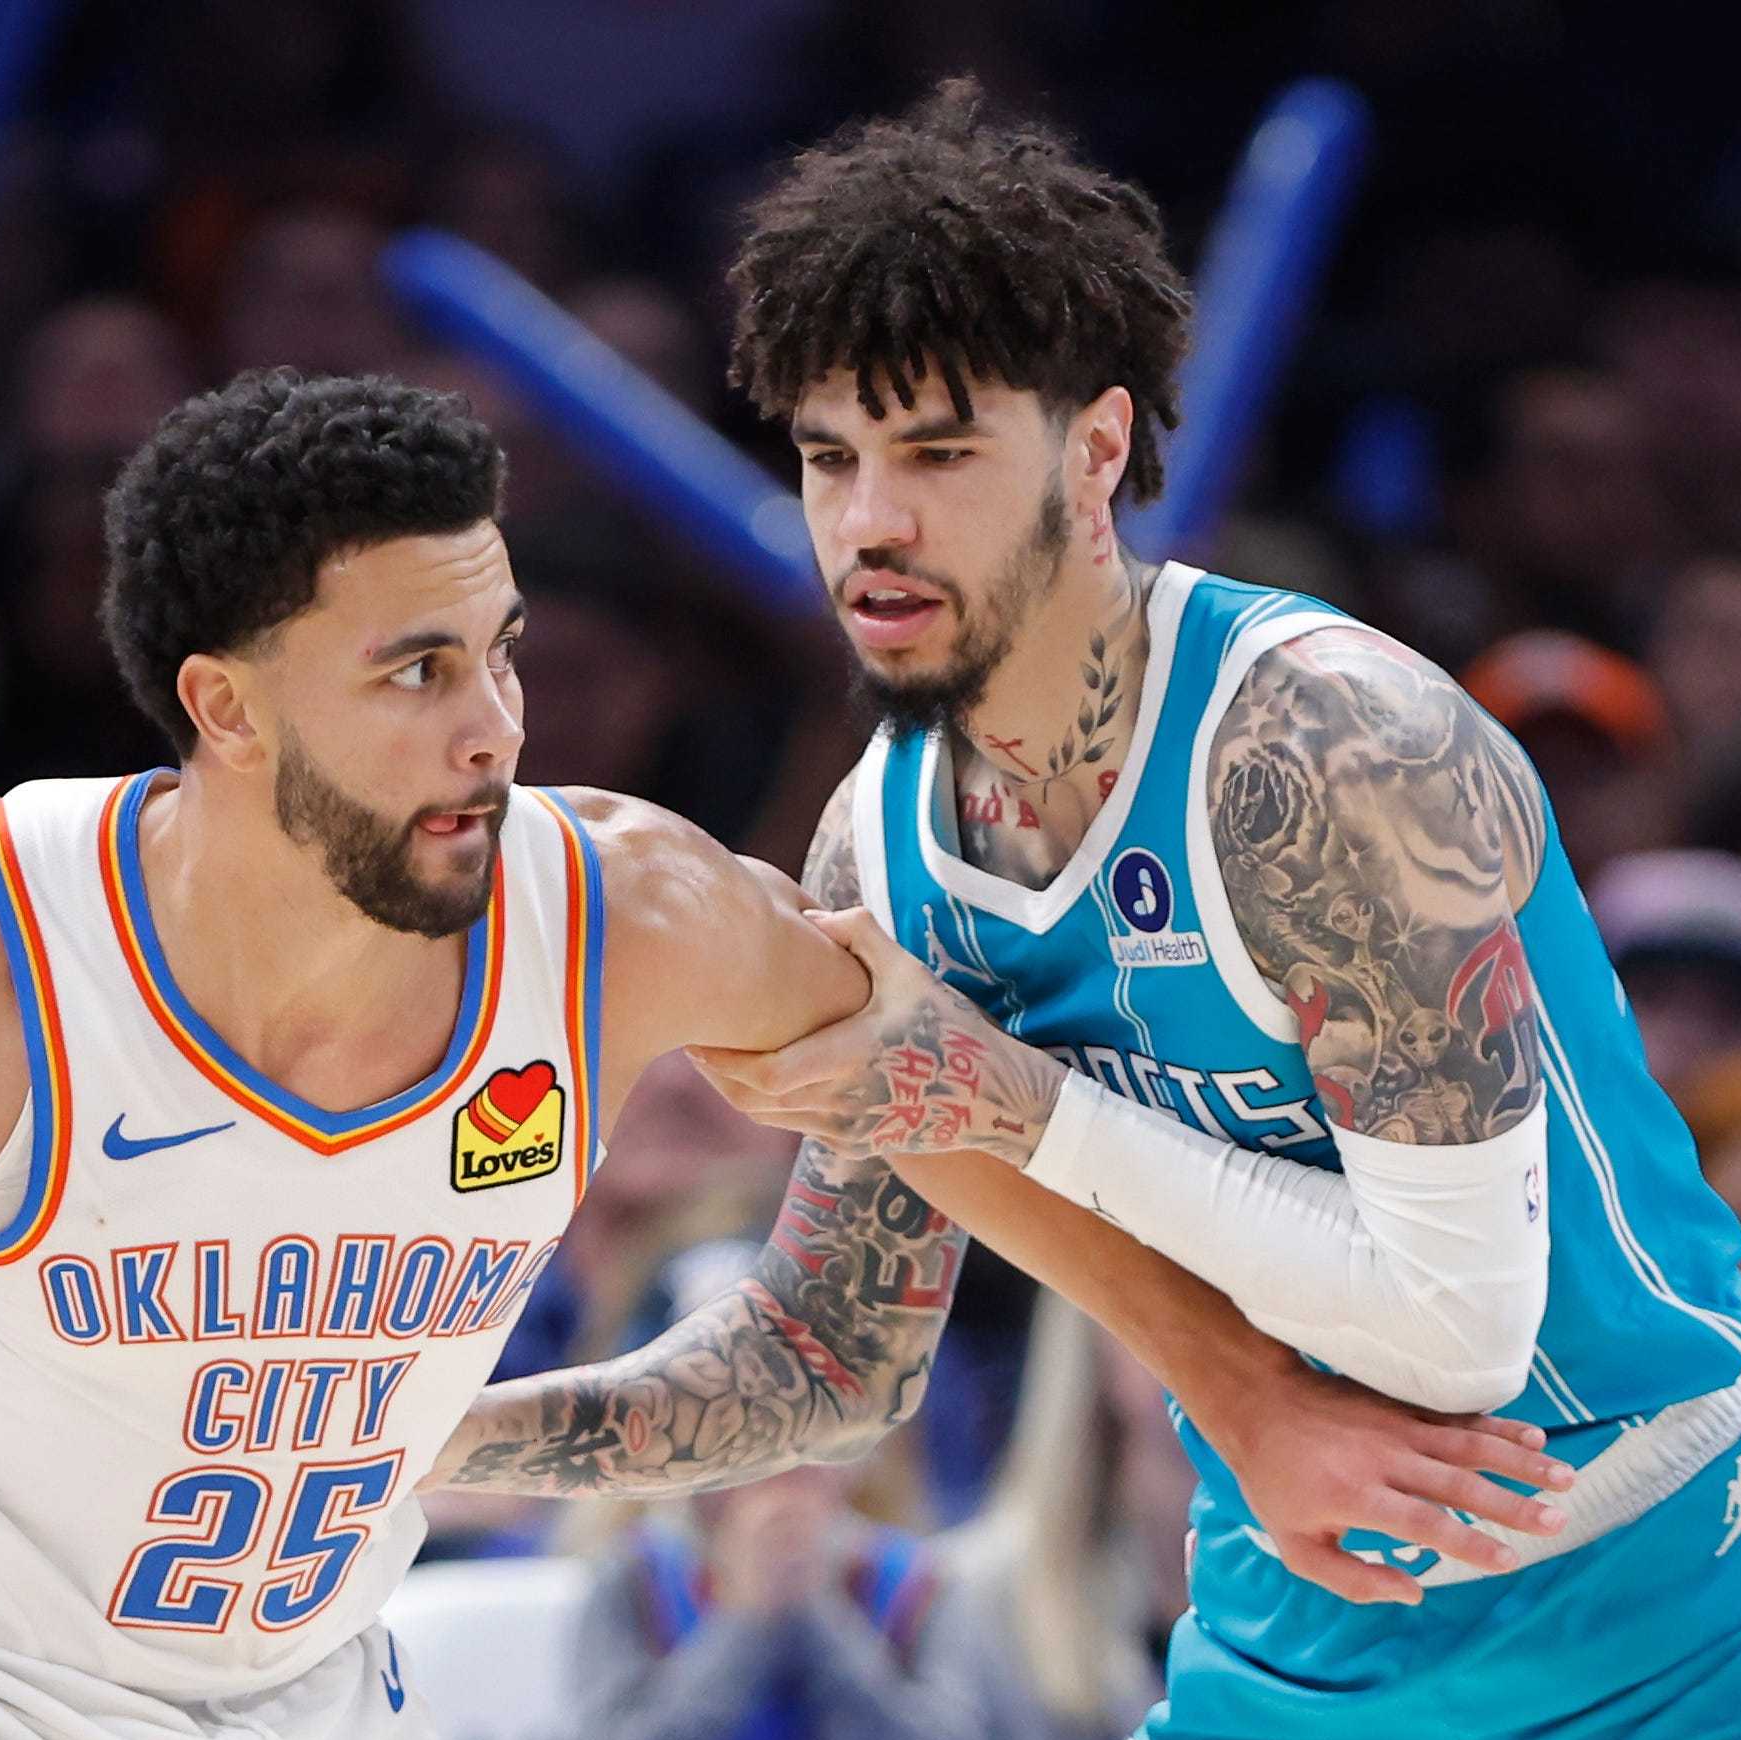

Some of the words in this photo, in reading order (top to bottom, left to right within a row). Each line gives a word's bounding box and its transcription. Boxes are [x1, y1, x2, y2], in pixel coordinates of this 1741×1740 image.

[1115, 939, 1151, 964] Judi
[1154, 937, 1203, 961] Health
[184, 1350, 420, 1456] CITY
[106, 1447, 408, 1635] 25
